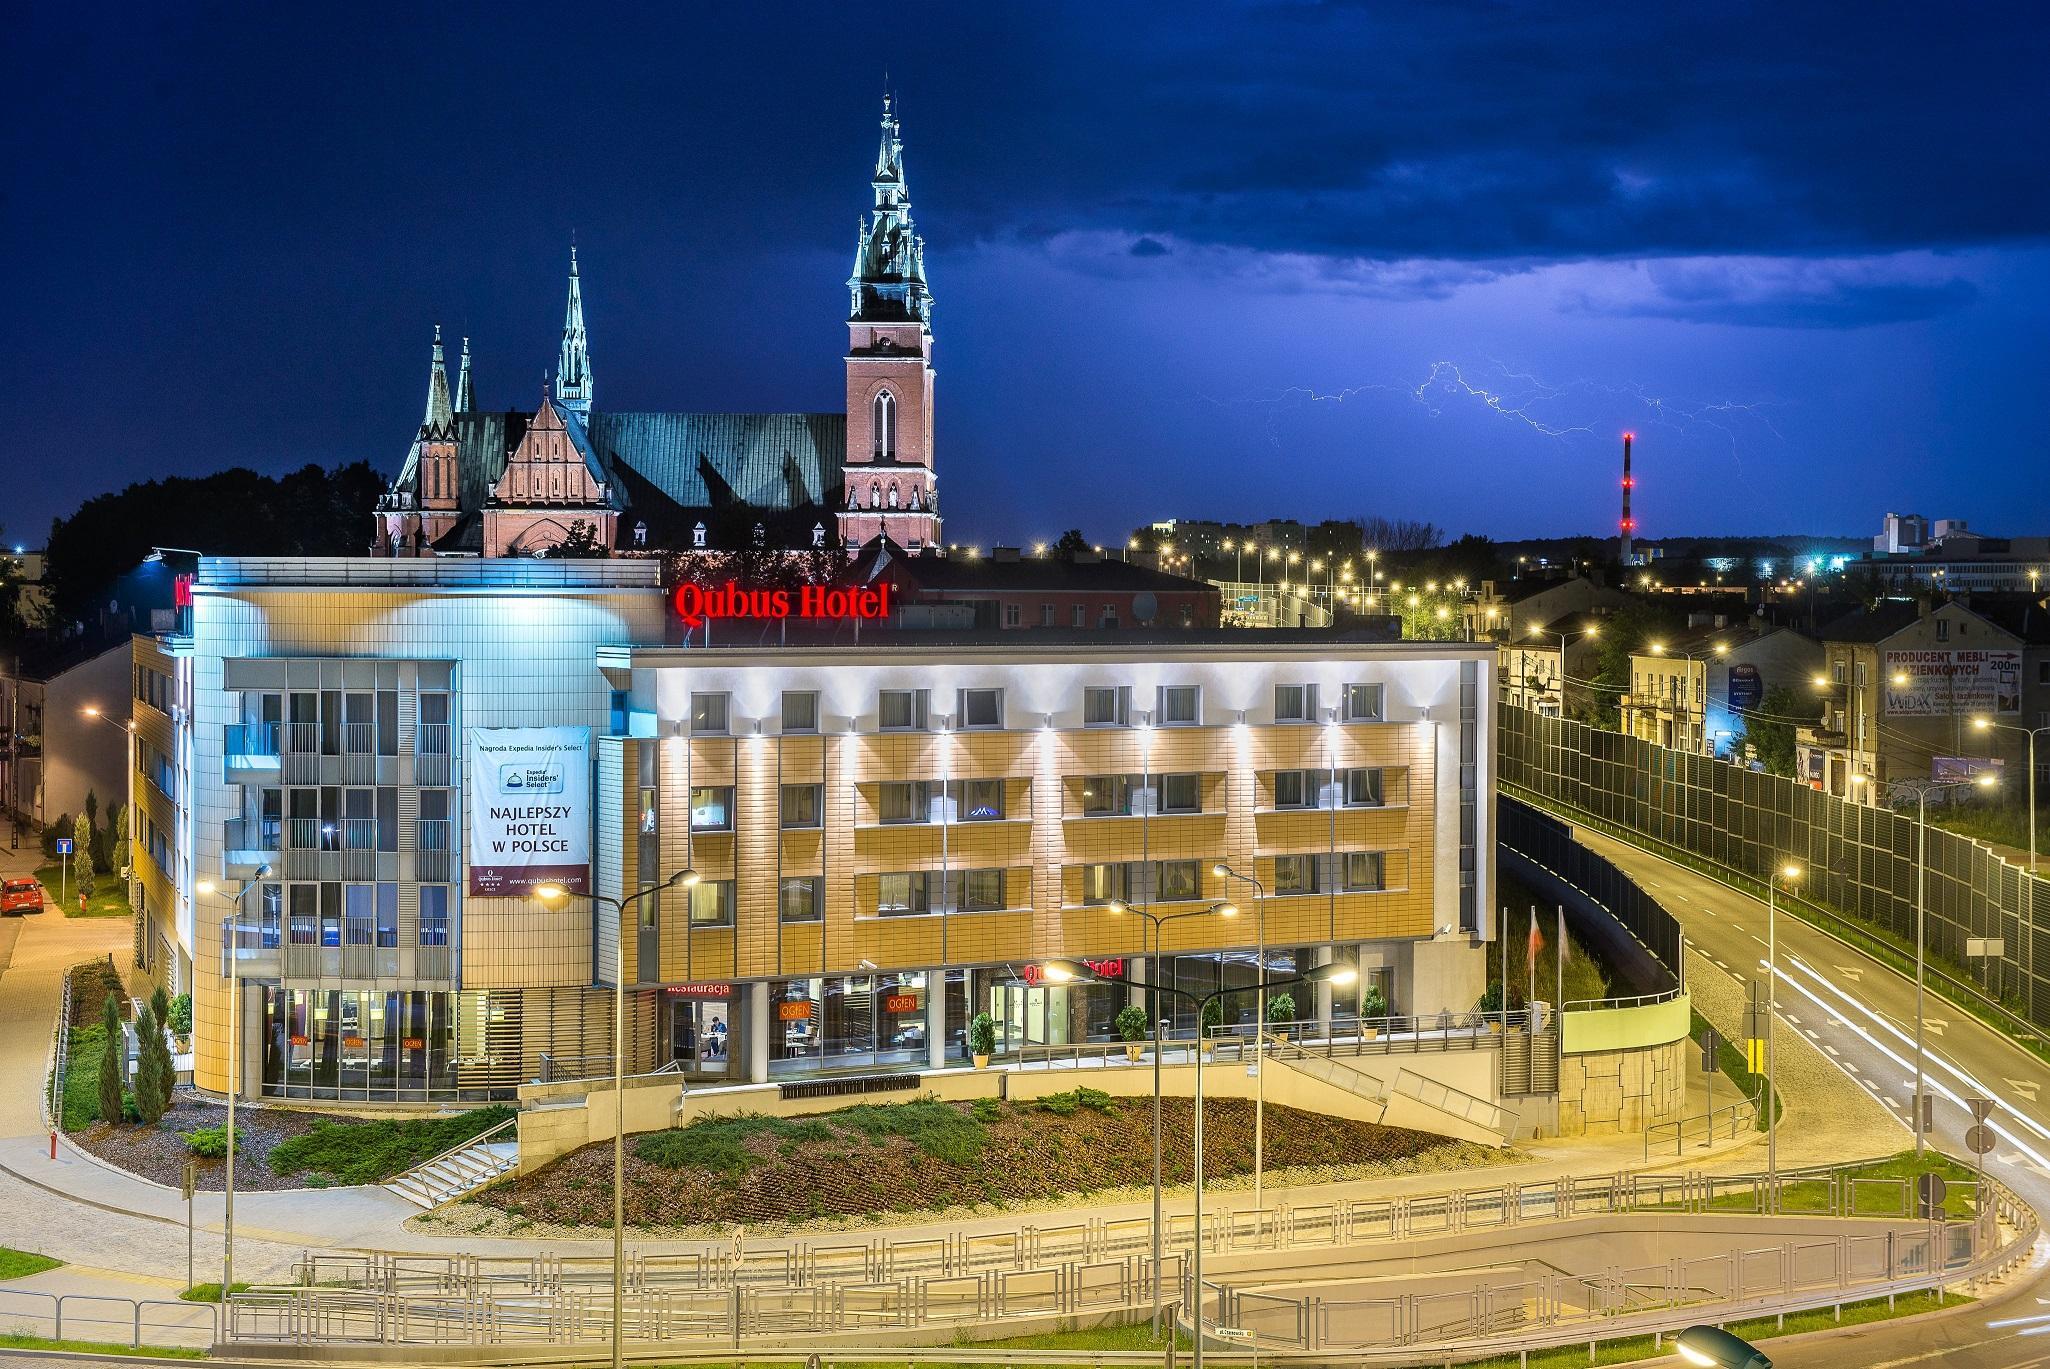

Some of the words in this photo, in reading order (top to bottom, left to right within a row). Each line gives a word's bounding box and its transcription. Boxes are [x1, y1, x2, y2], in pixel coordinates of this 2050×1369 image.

[676, 581, 790, 628] Qubus
[800, 583, 889, 618] Hotel
[1887, 652, 1951, 663] PRODUCENT
[1957, 652, 1989, 663] MEBLI
[1990, 660, 2021, 670] 200m
[480, 745, 507, 753] Nagroda
[526, 774, 559, 782] Insiders'
[490, 806, 572, 821] NAJLEPSZY
[506, 823, 557, 836] HOTEL
[492, 841, 506, 853] W
[512, 840, 569, 853] POLSCE
